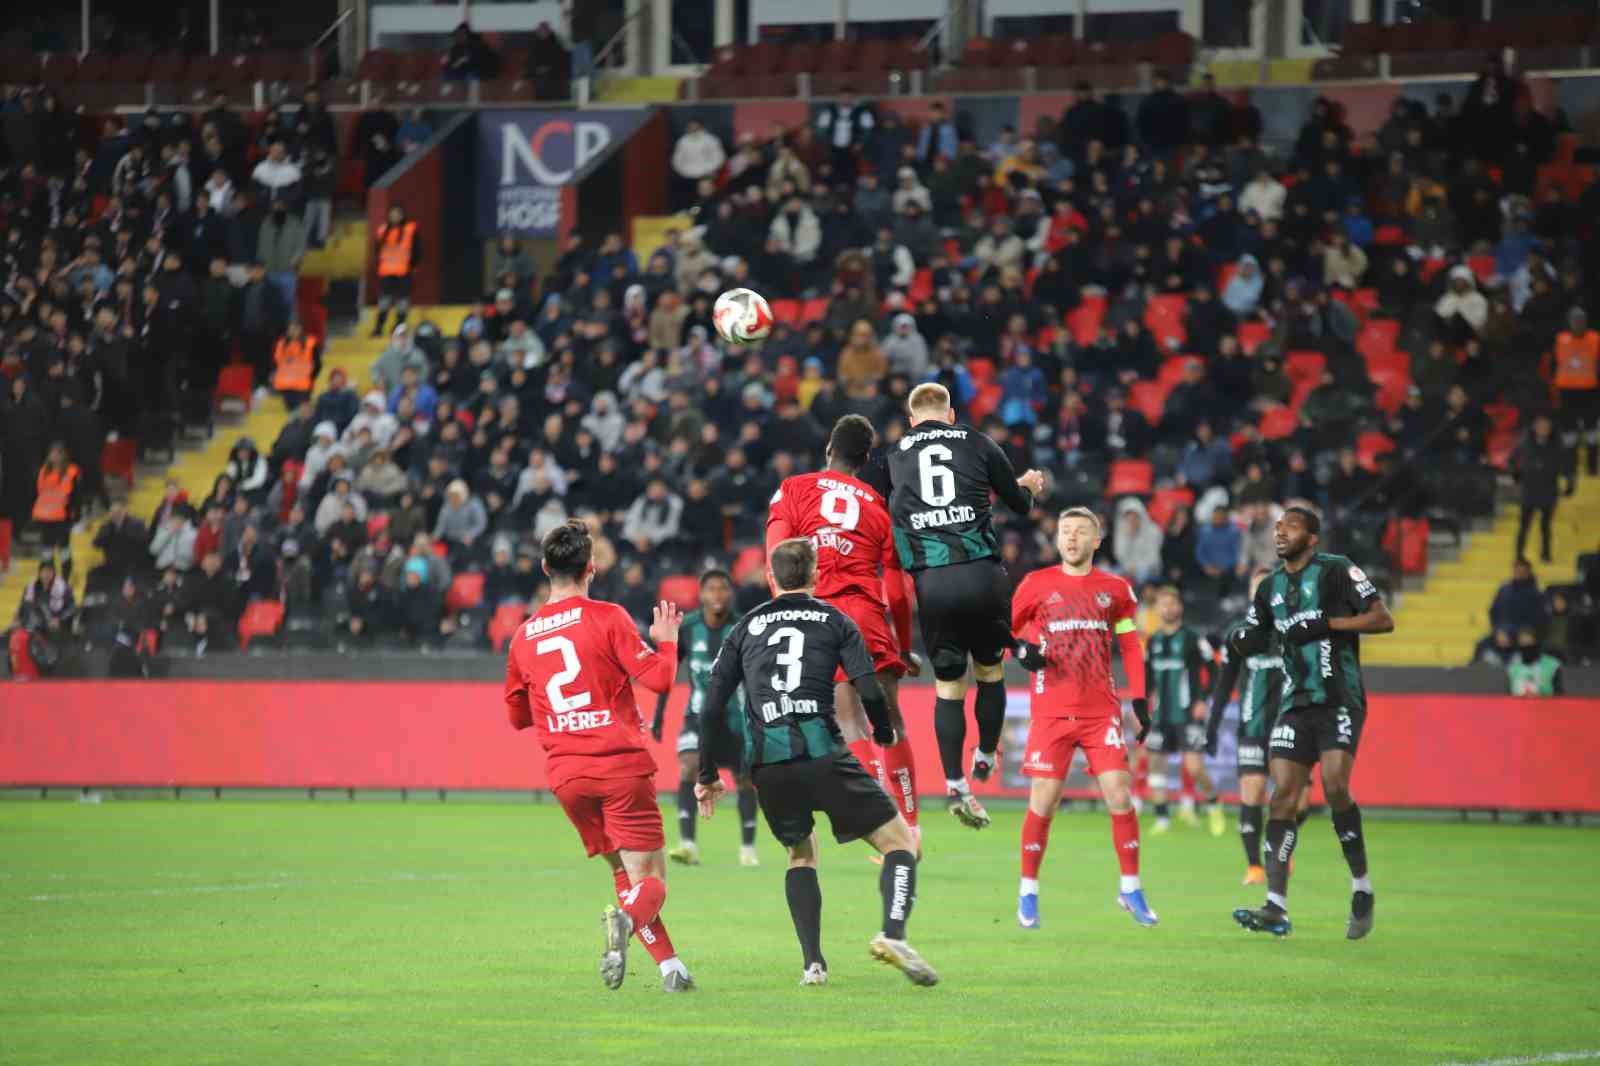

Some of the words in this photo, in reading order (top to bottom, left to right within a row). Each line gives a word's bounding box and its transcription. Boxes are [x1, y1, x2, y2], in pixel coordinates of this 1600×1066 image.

[918, 443, 956, 507] 6
[820, 490, 860, 530] 9
[536, 635, 592, 714] 2
[767, 627, 805, 693] 3
